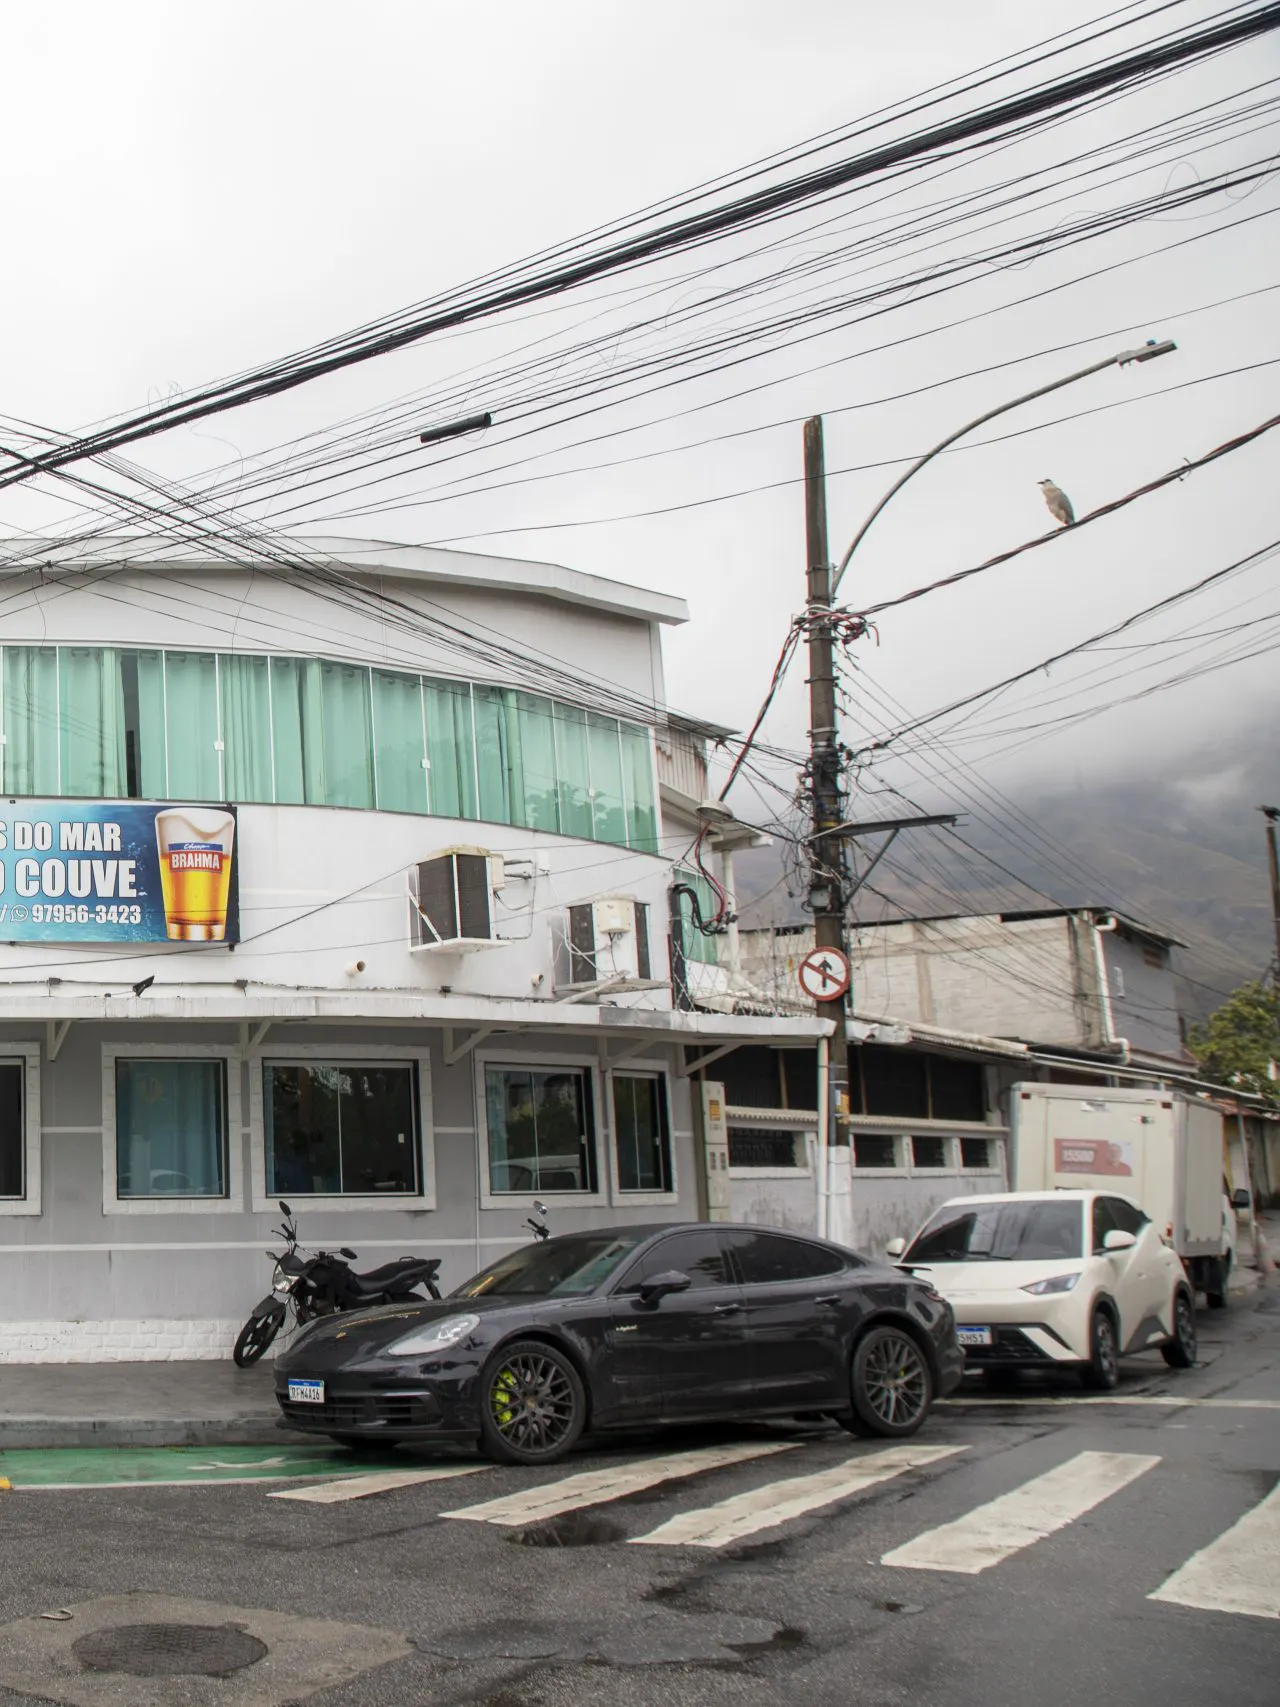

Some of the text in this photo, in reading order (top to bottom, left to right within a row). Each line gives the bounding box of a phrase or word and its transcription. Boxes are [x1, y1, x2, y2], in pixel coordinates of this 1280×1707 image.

[13, 821, 55, 852] DO
[59, 822, 122, 852] MAR
[171, 853, 220, 869] BRAHMA
[14, 858, 137, 898] COUVE
[32, 904, 141, 924] 97956-3423
